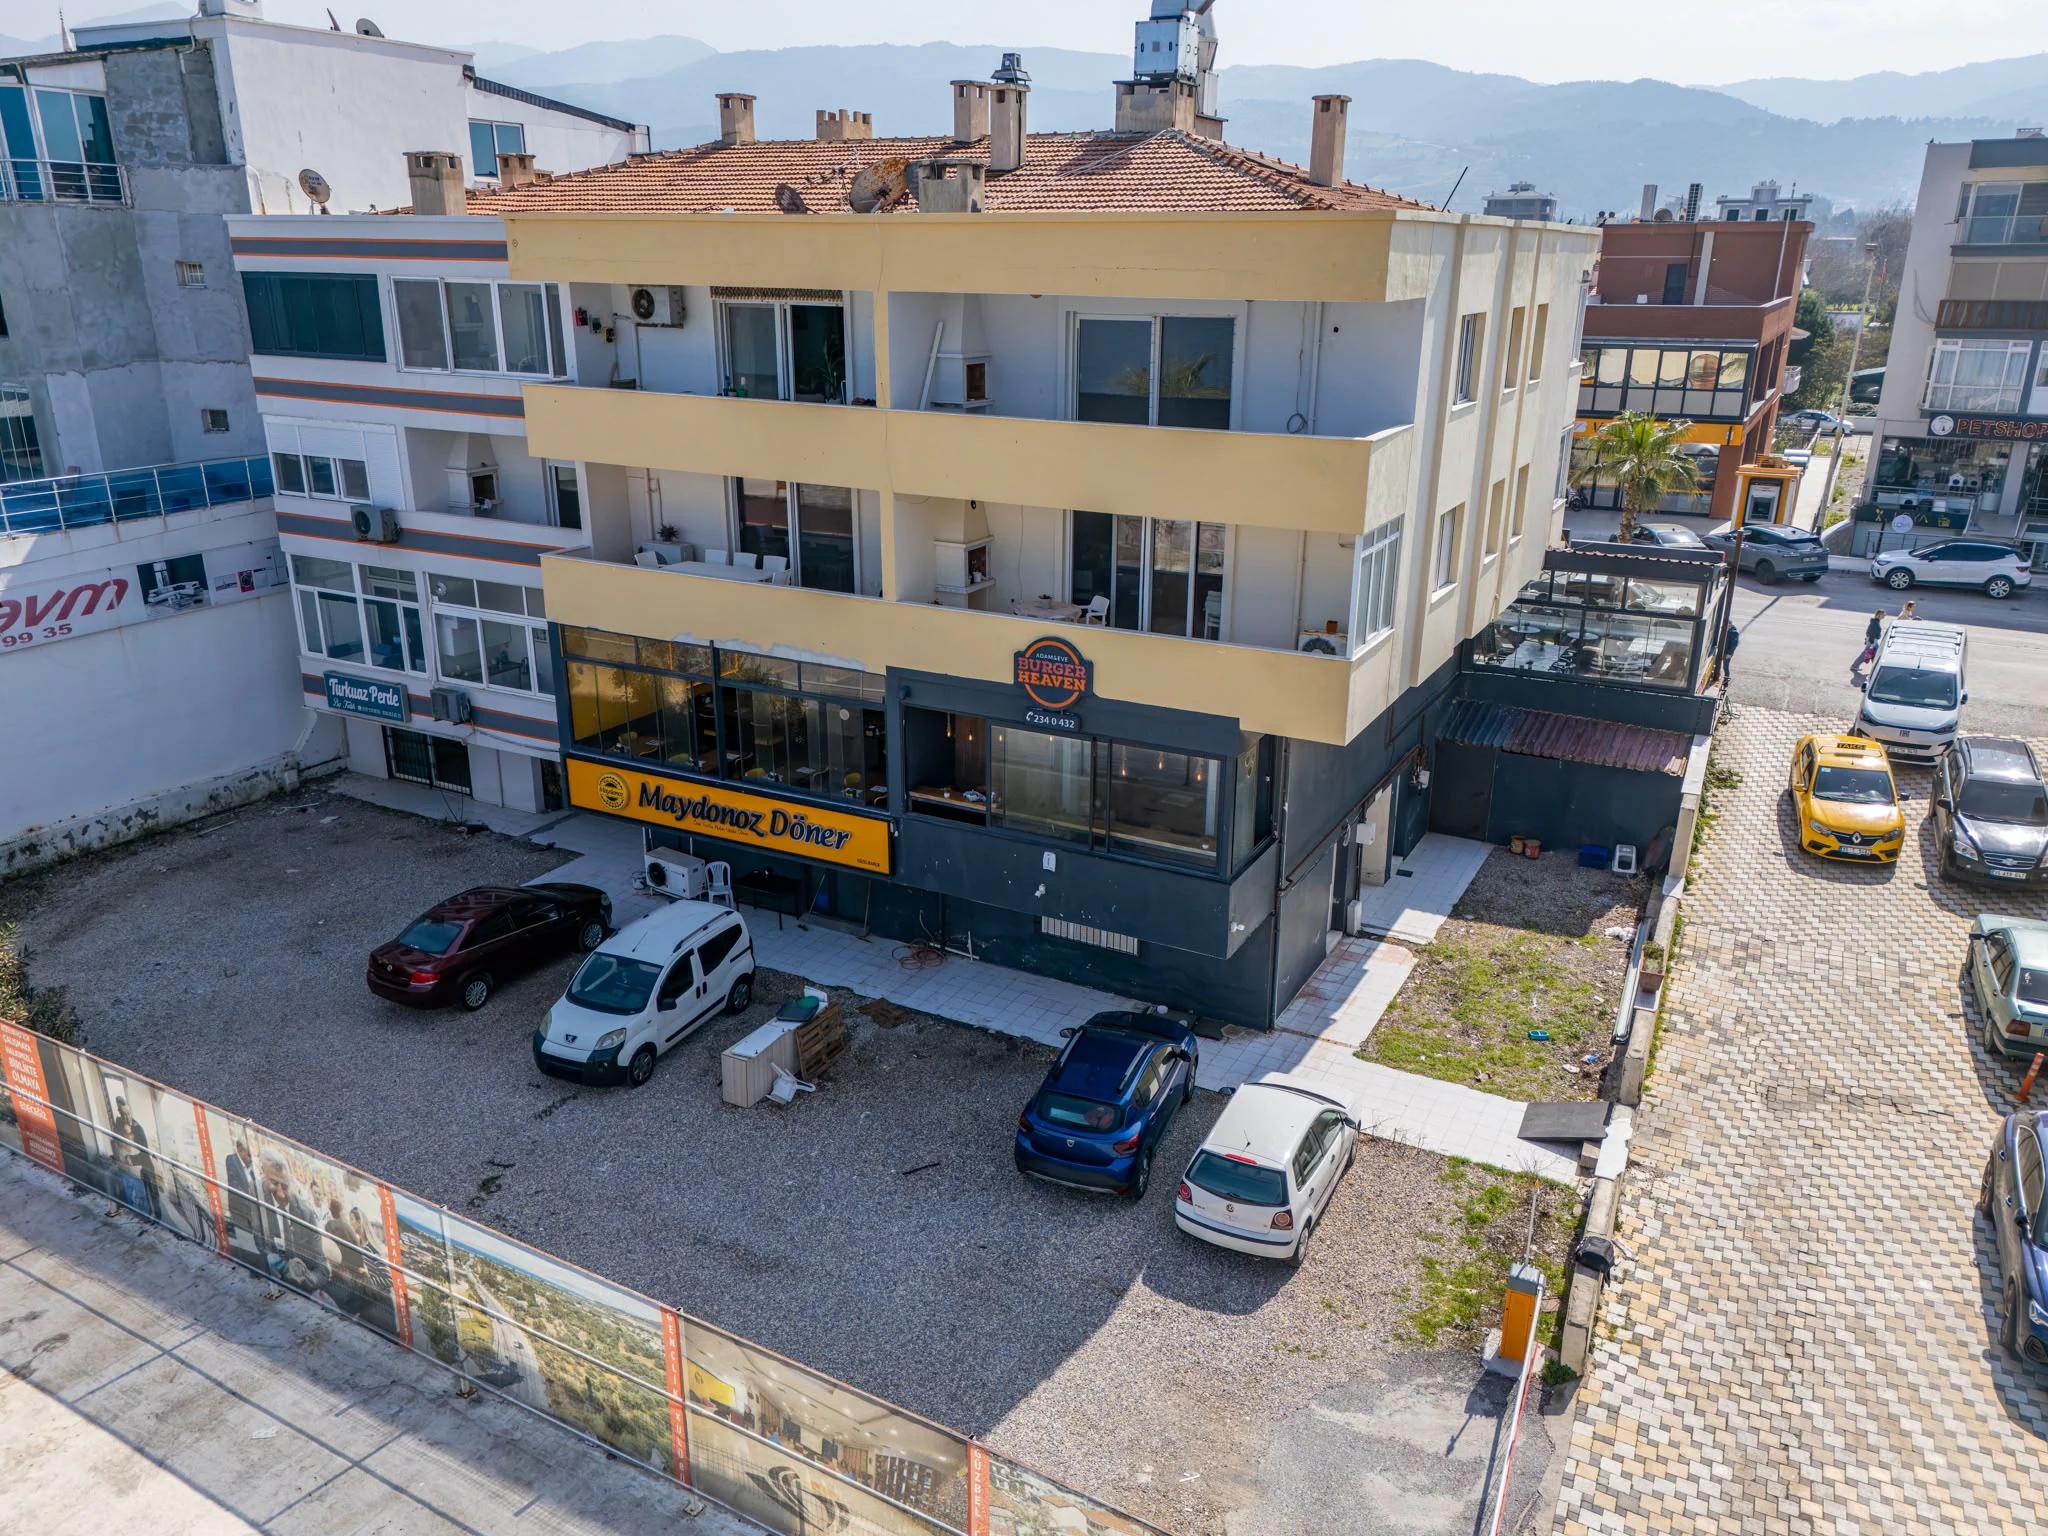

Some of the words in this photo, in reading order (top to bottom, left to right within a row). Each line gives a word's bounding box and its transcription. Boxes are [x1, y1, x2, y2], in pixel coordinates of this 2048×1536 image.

[1956, 418, 2048, 438] PETSHOP
[42, 623, 73, 639] 35
[1018, 657, 1086, 678] BURGER
[1018, 670, 1086, 692] HEAVEN
[329, 678, 369, 701] Turkuaz
[369, 685, 400, 706] Perde
[1033, 714, 1050, 724] 234
[1058, 719, 1075, 729] 432
[638, 782, 767, 838] Maydonoz
[769, 808, 851, 850] Döner
